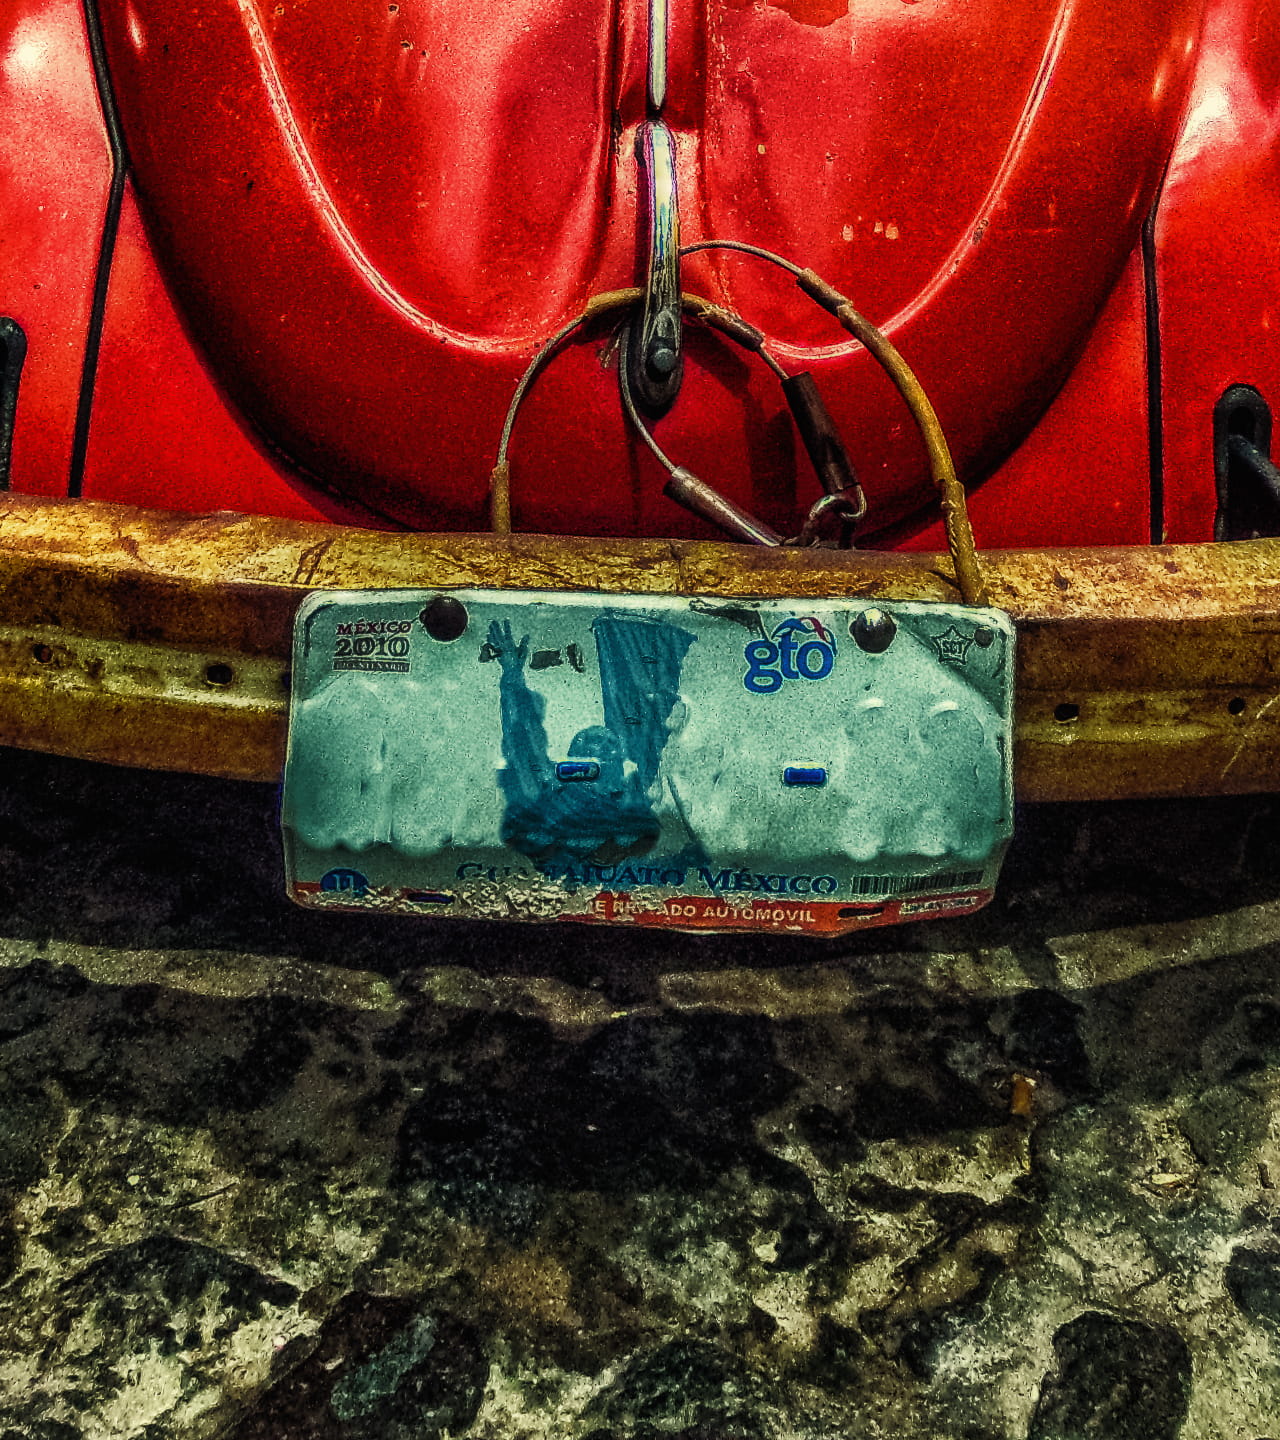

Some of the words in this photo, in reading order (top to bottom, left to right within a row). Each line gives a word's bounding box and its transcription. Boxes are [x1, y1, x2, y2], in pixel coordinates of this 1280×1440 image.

[336, 617, 412, 636] MÉXICO
[334, 636, 410, 657] 2010
[743, 631, 835, 694] gto
[698, 867, 839, 895] MÉXICO
